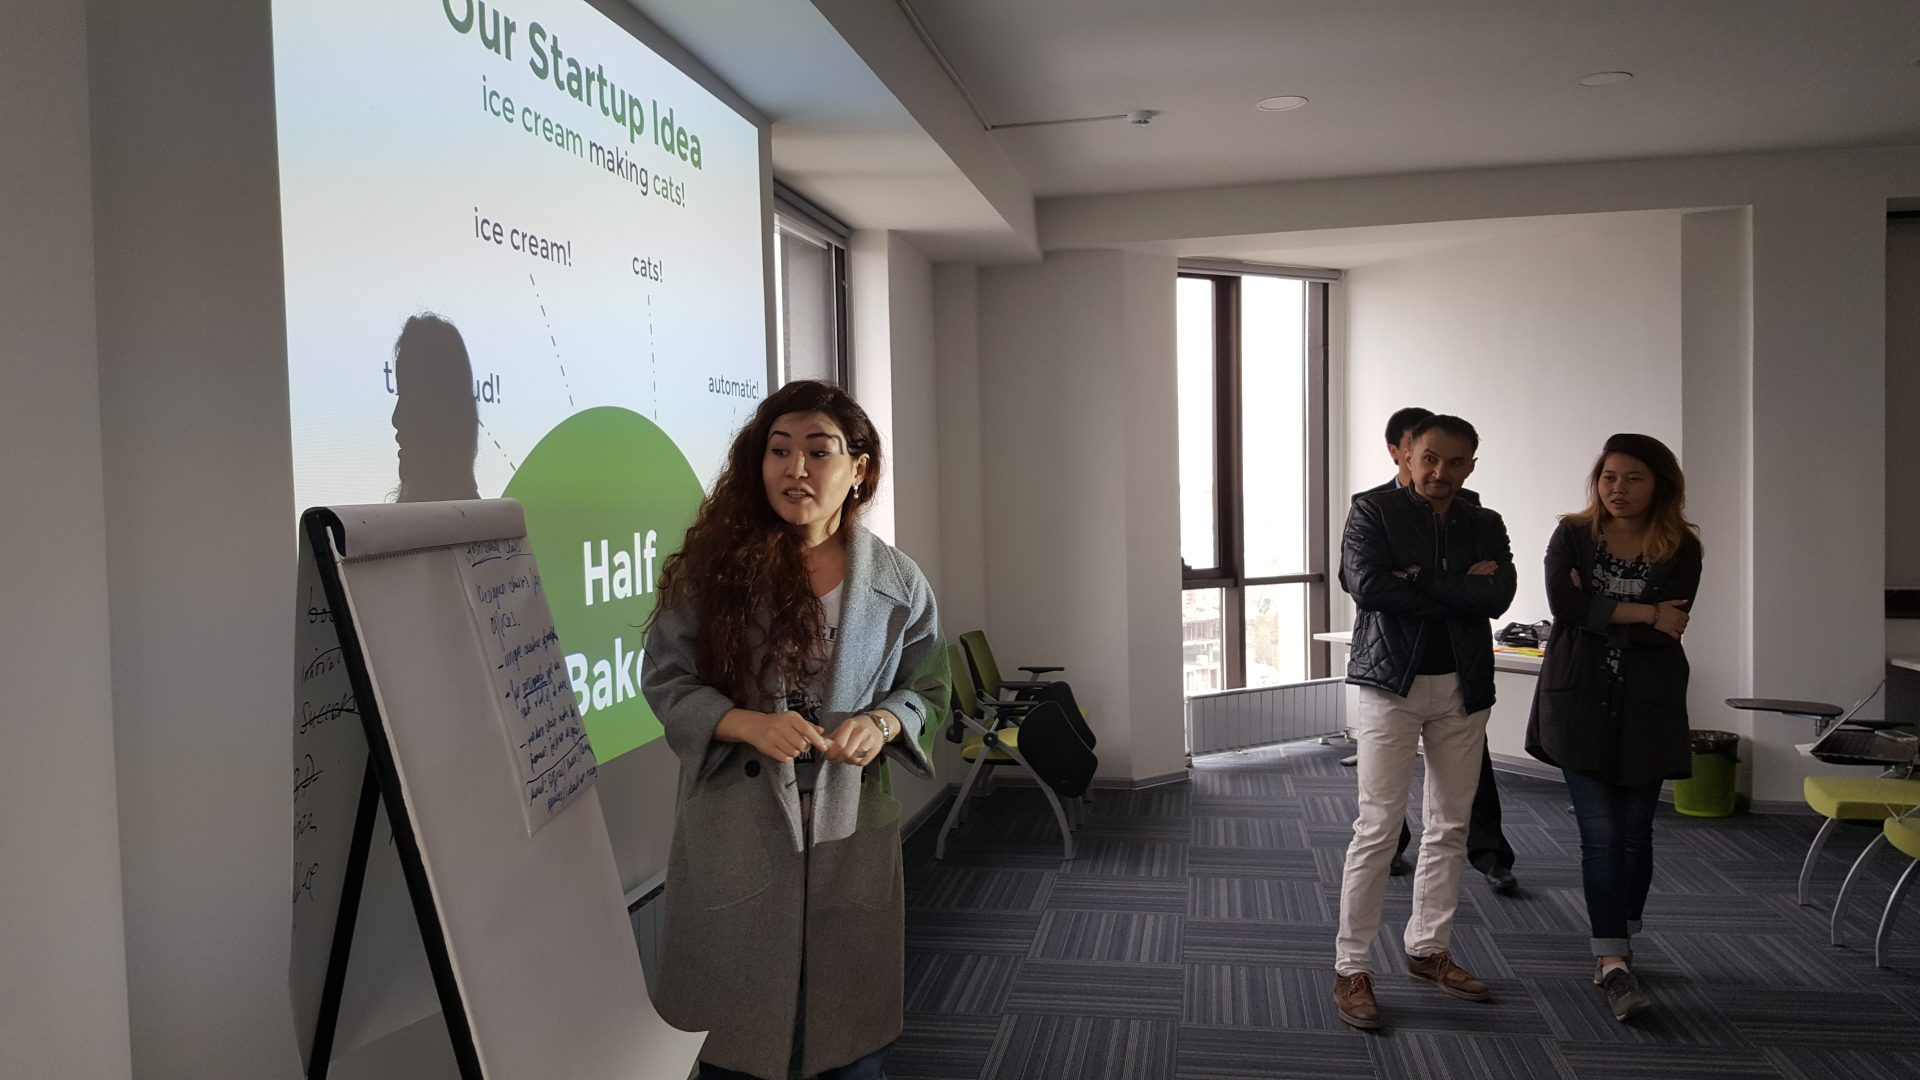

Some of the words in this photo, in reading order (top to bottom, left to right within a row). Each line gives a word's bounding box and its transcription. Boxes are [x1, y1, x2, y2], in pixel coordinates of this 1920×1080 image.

[442, 0, 516, 61] Our
[528, 21, 645, 144] Startup
[652, 99, 702, 171] Idea
[482, 74, 515, 124] ice
[521, 106, 584, 158] cream
[589, 139, 649, 197] making
[653, 172, 686, 208] cats!
[474, 207, 504, 245] ice
[510, 226, 573, 267] cream!
[632, 255, 663, 283] cats!
[708, 374, 759, 400] automatic!
[583, 529, 657, 606] Half
[564, 637, 645, 718] Bak
